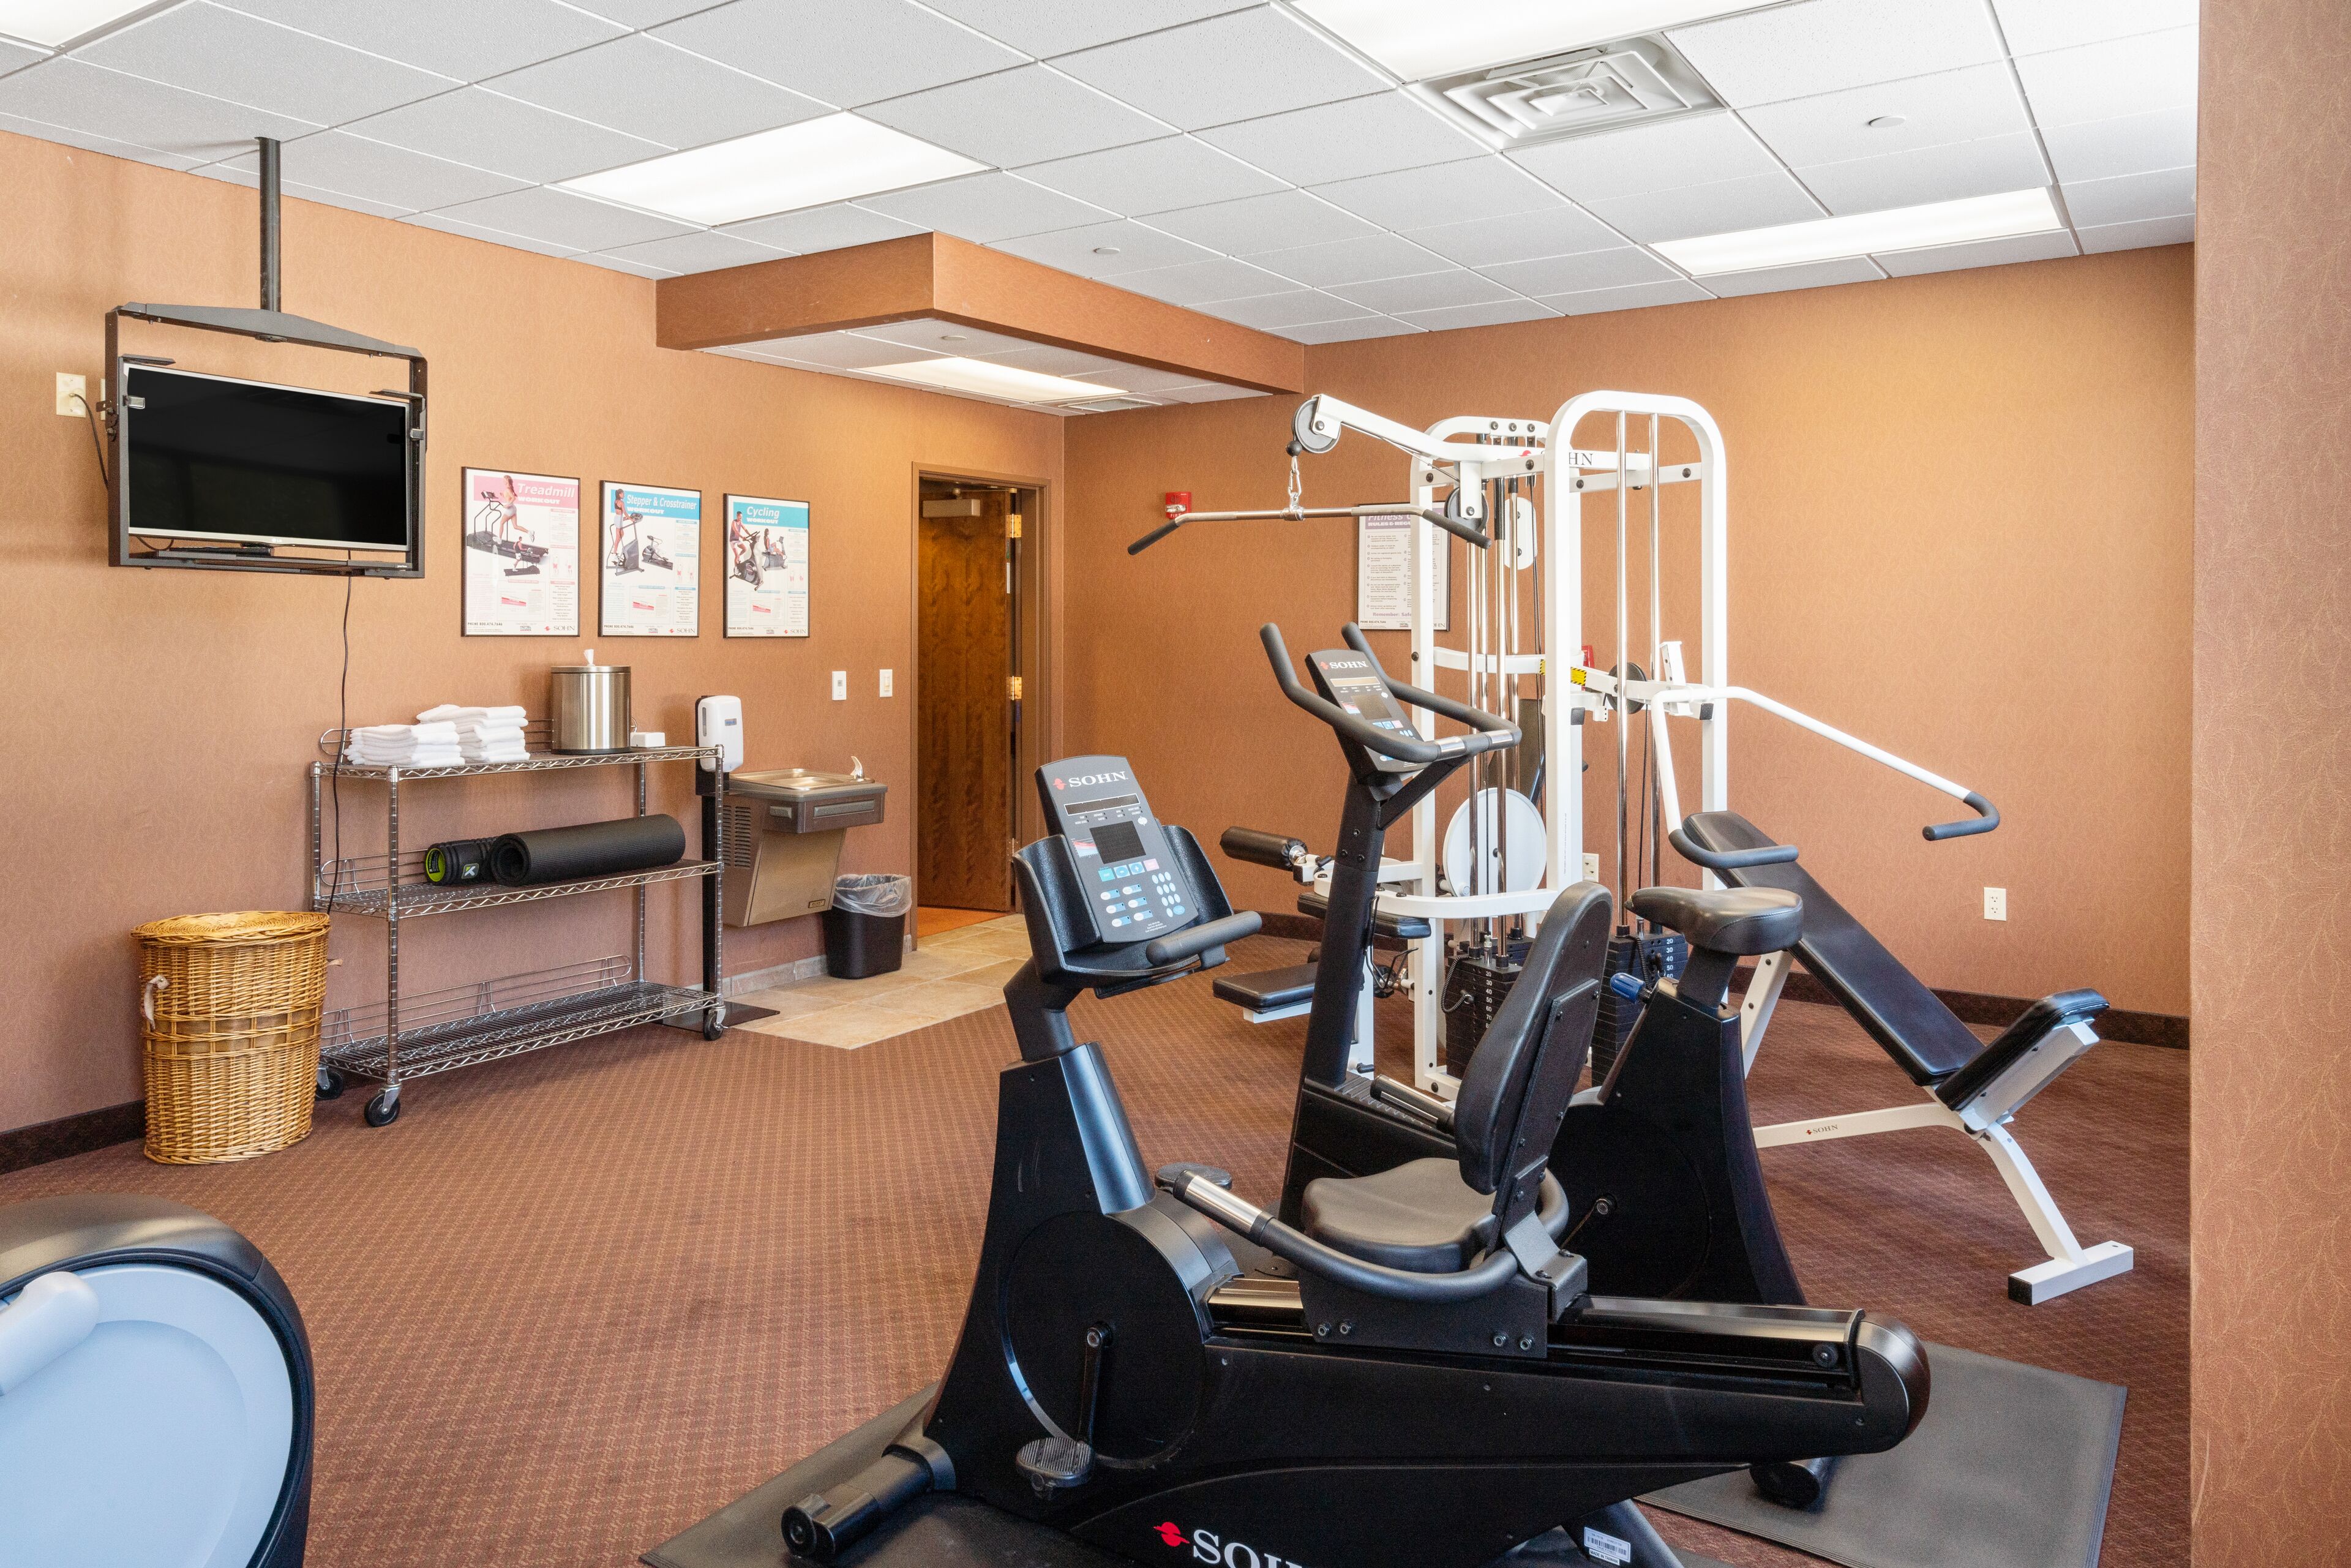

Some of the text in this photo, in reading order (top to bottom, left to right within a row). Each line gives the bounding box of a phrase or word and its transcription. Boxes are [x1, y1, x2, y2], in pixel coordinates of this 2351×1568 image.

[517, 483, 575, 498] Treadmill
[518, 496, 560, 505] WORKOUT
[626, 494, 697, 509] Stepper & Crosstrainer
[746, 506, 780, 519] Cycling
[1329, 661, 1368, 669] SOHN
[1068, 771, 1127, 788] SOHN
[1813, 1124, 1838, 1133] SOHN
[1193, 1529, 1302, 1568] SO
[1605, 1555, 1618, 1563] TAIWAN
